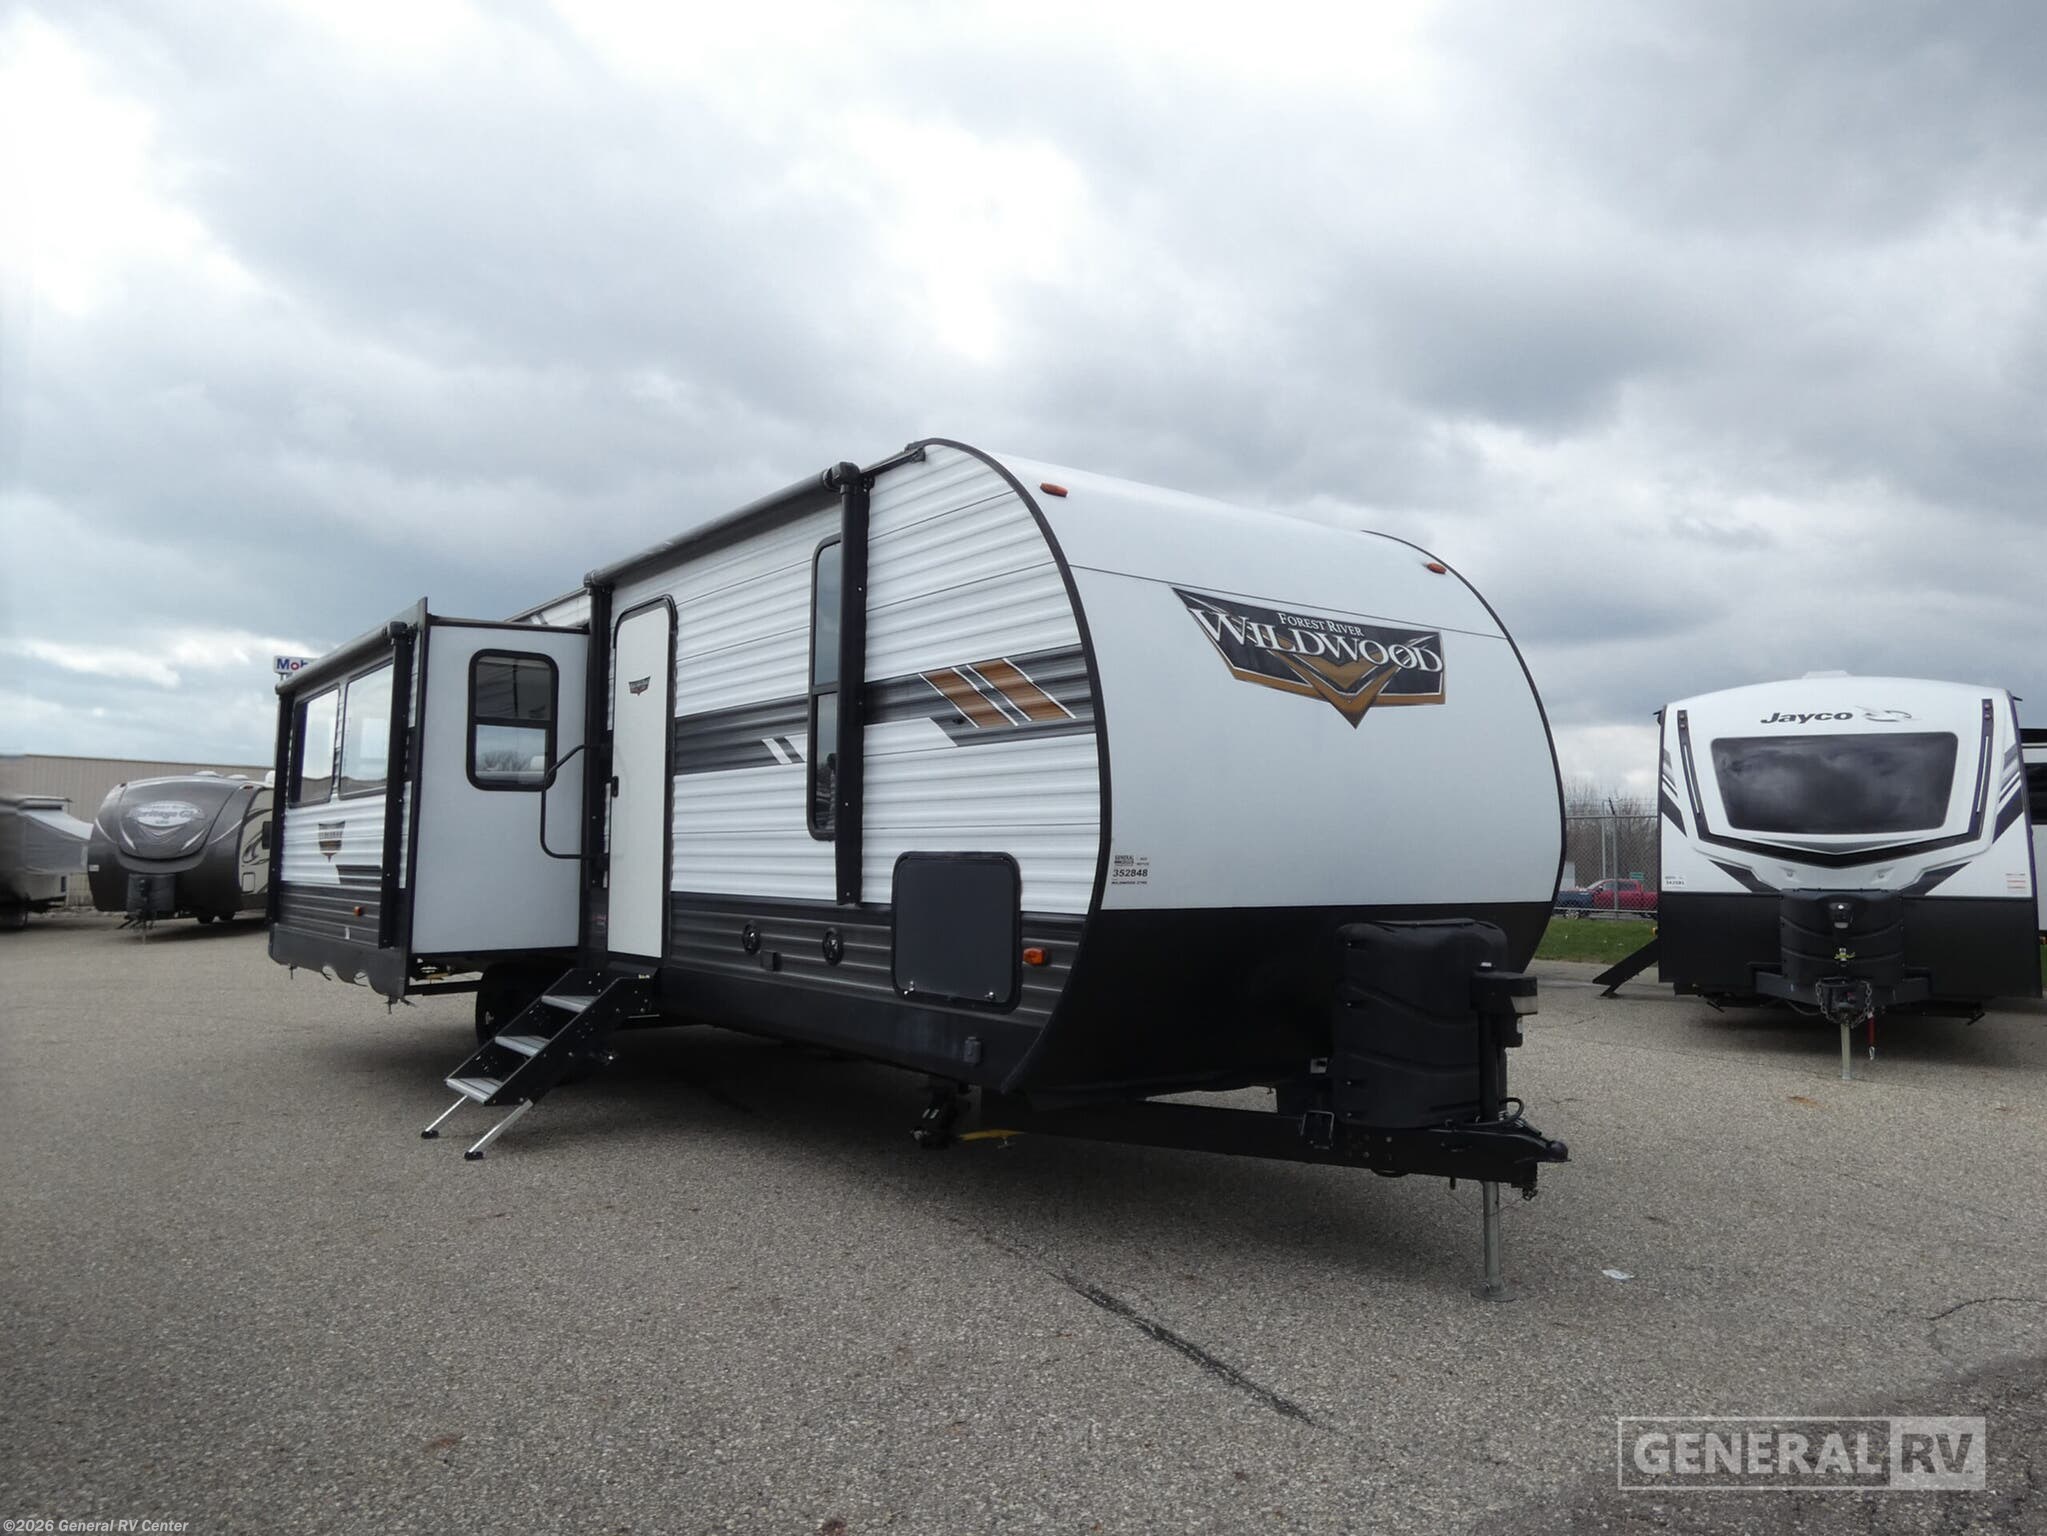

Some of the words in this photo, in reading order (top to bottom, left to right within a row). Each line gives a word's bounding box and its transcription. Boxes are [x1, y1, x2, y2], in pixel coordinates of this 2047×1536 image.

[1278, 612, 1327, 631] FOREST
[1327, 619, 1365, 638] RIVER
[1187, 607, 1444, 672] WILDWOOD
[1760, 711, 1854, 725] Jayco
[1112, 869, 1149, 877] 352848
